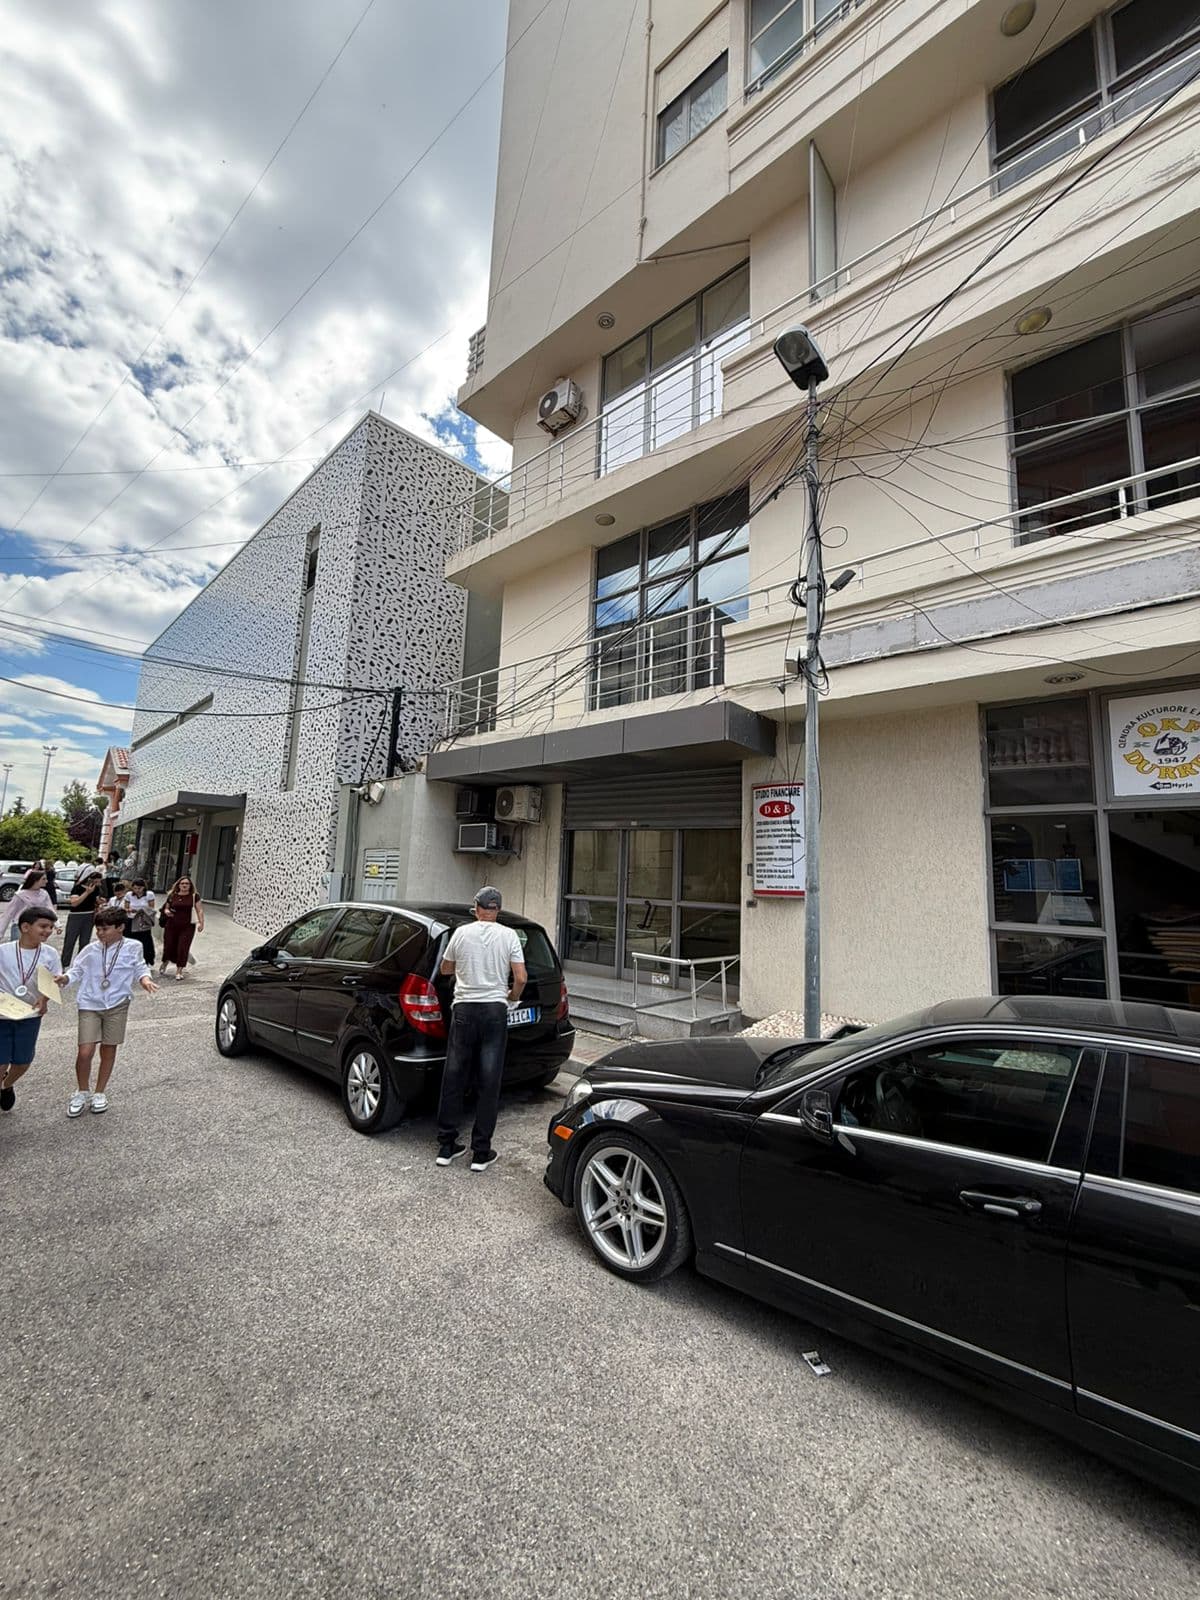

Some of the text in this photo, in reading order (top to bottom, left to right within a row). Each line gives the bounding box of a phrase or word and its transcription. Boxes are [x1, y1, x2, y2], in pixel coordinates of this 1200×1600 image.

[1118, 720, 1137, 748] QENDRA
[1136, 705, 1188, 722] KULTURORE
[1158, 756, 1187, 765] 1947
[764, 805, 771, 814] D
[773, 804, 781, 814] &
